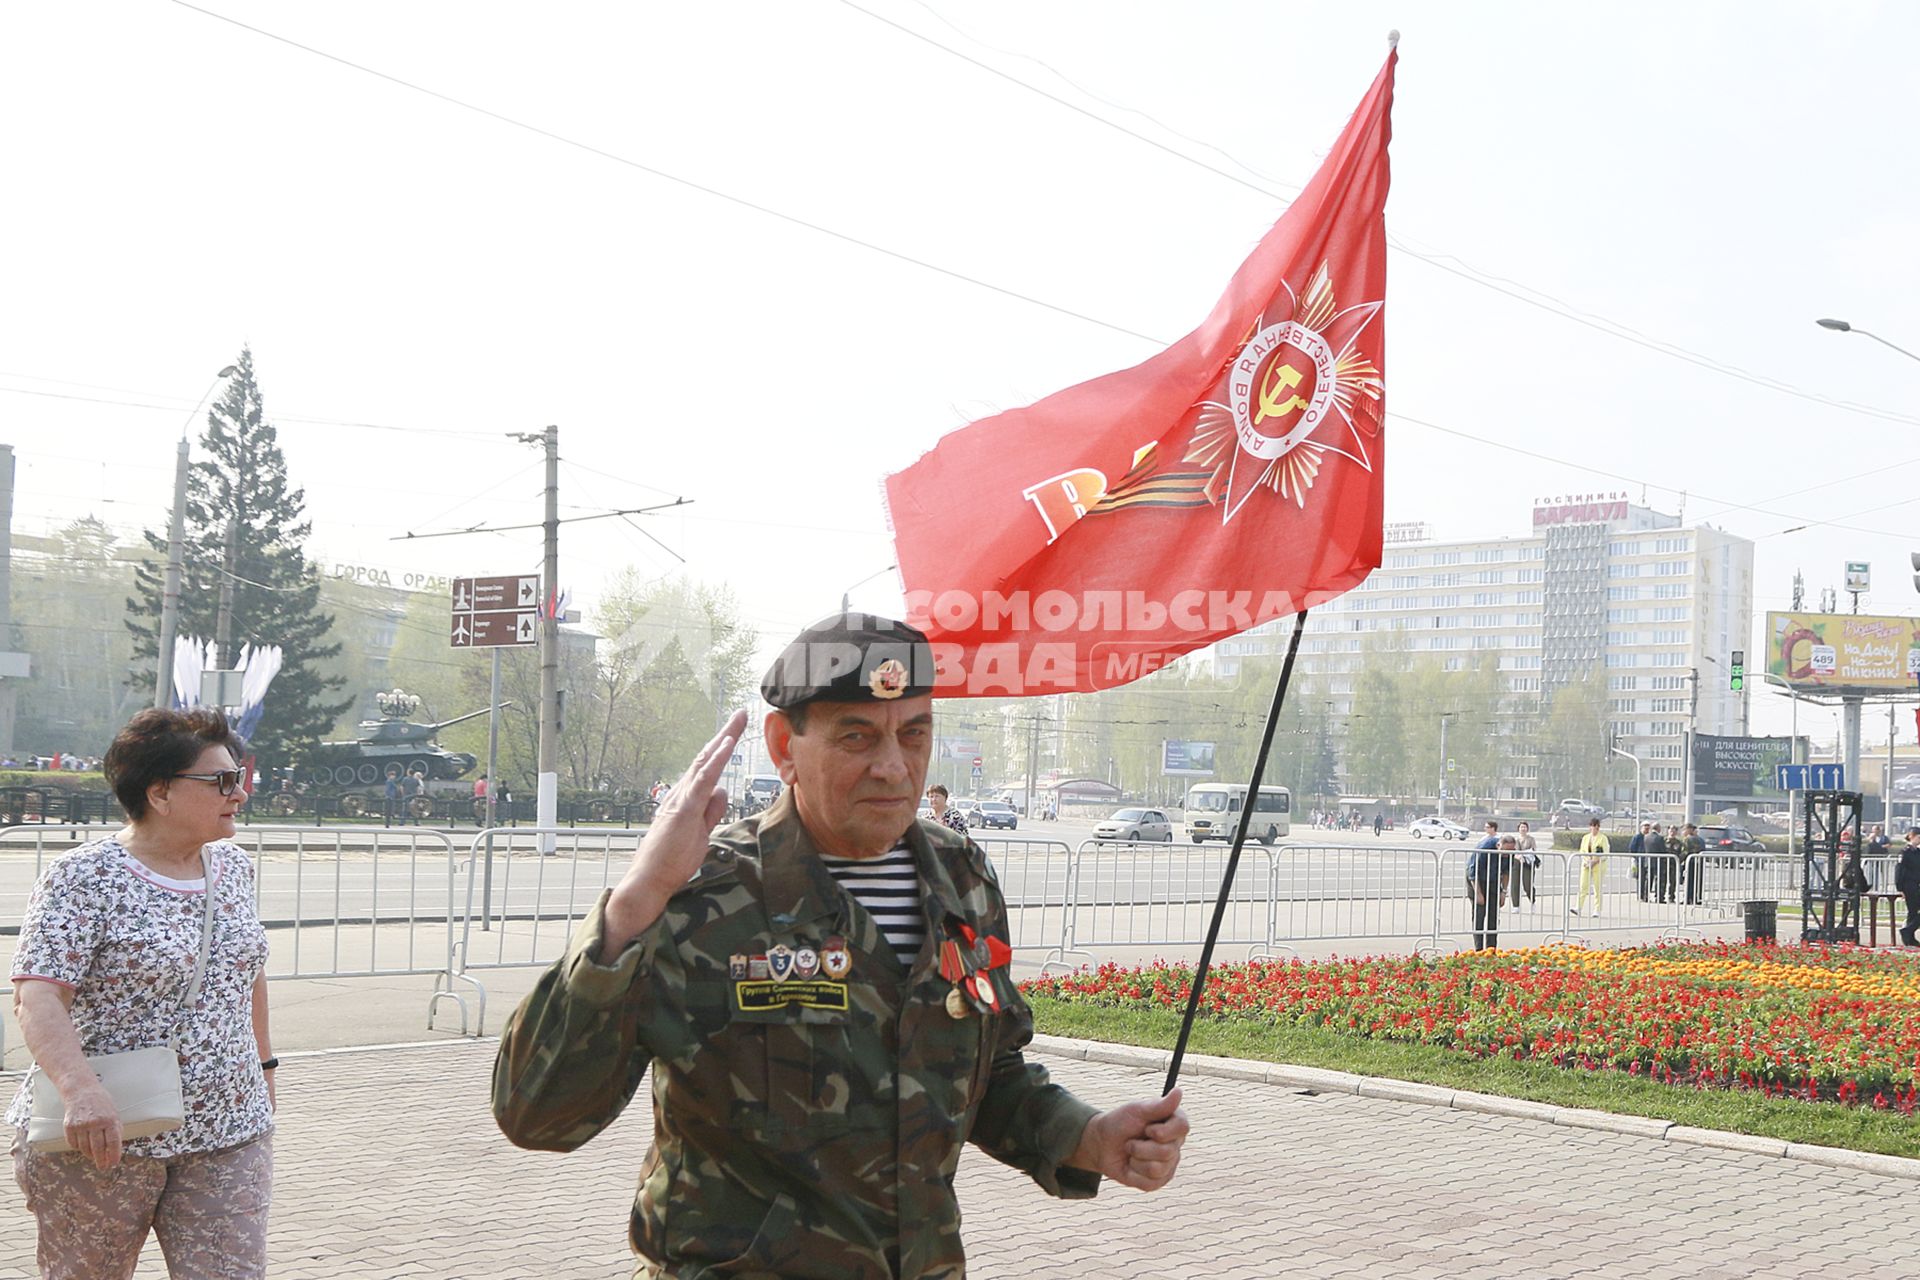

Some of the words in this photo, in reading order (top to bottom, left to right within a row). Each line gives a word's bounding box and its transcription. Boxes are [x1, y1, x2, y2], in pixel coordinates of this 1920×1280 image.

[1534, 491, 1629, 506] ГОСТИНИЦА
[1533, 501, 1629, 526] БАРНАУЛ
[335, 563, 392, 586] ГОРОД
[403, 572, 453, 591] ОРДЕ
[1813, 655, 1834, 664] 489
[1715, 741, 1734, 750] ДЛЯ
[1715, 751, 1763, 760] ВЫСОКОГО
[1715, 761, 1765, 770] ИСКУССТВА
[776, 957, 785, 970] 3
